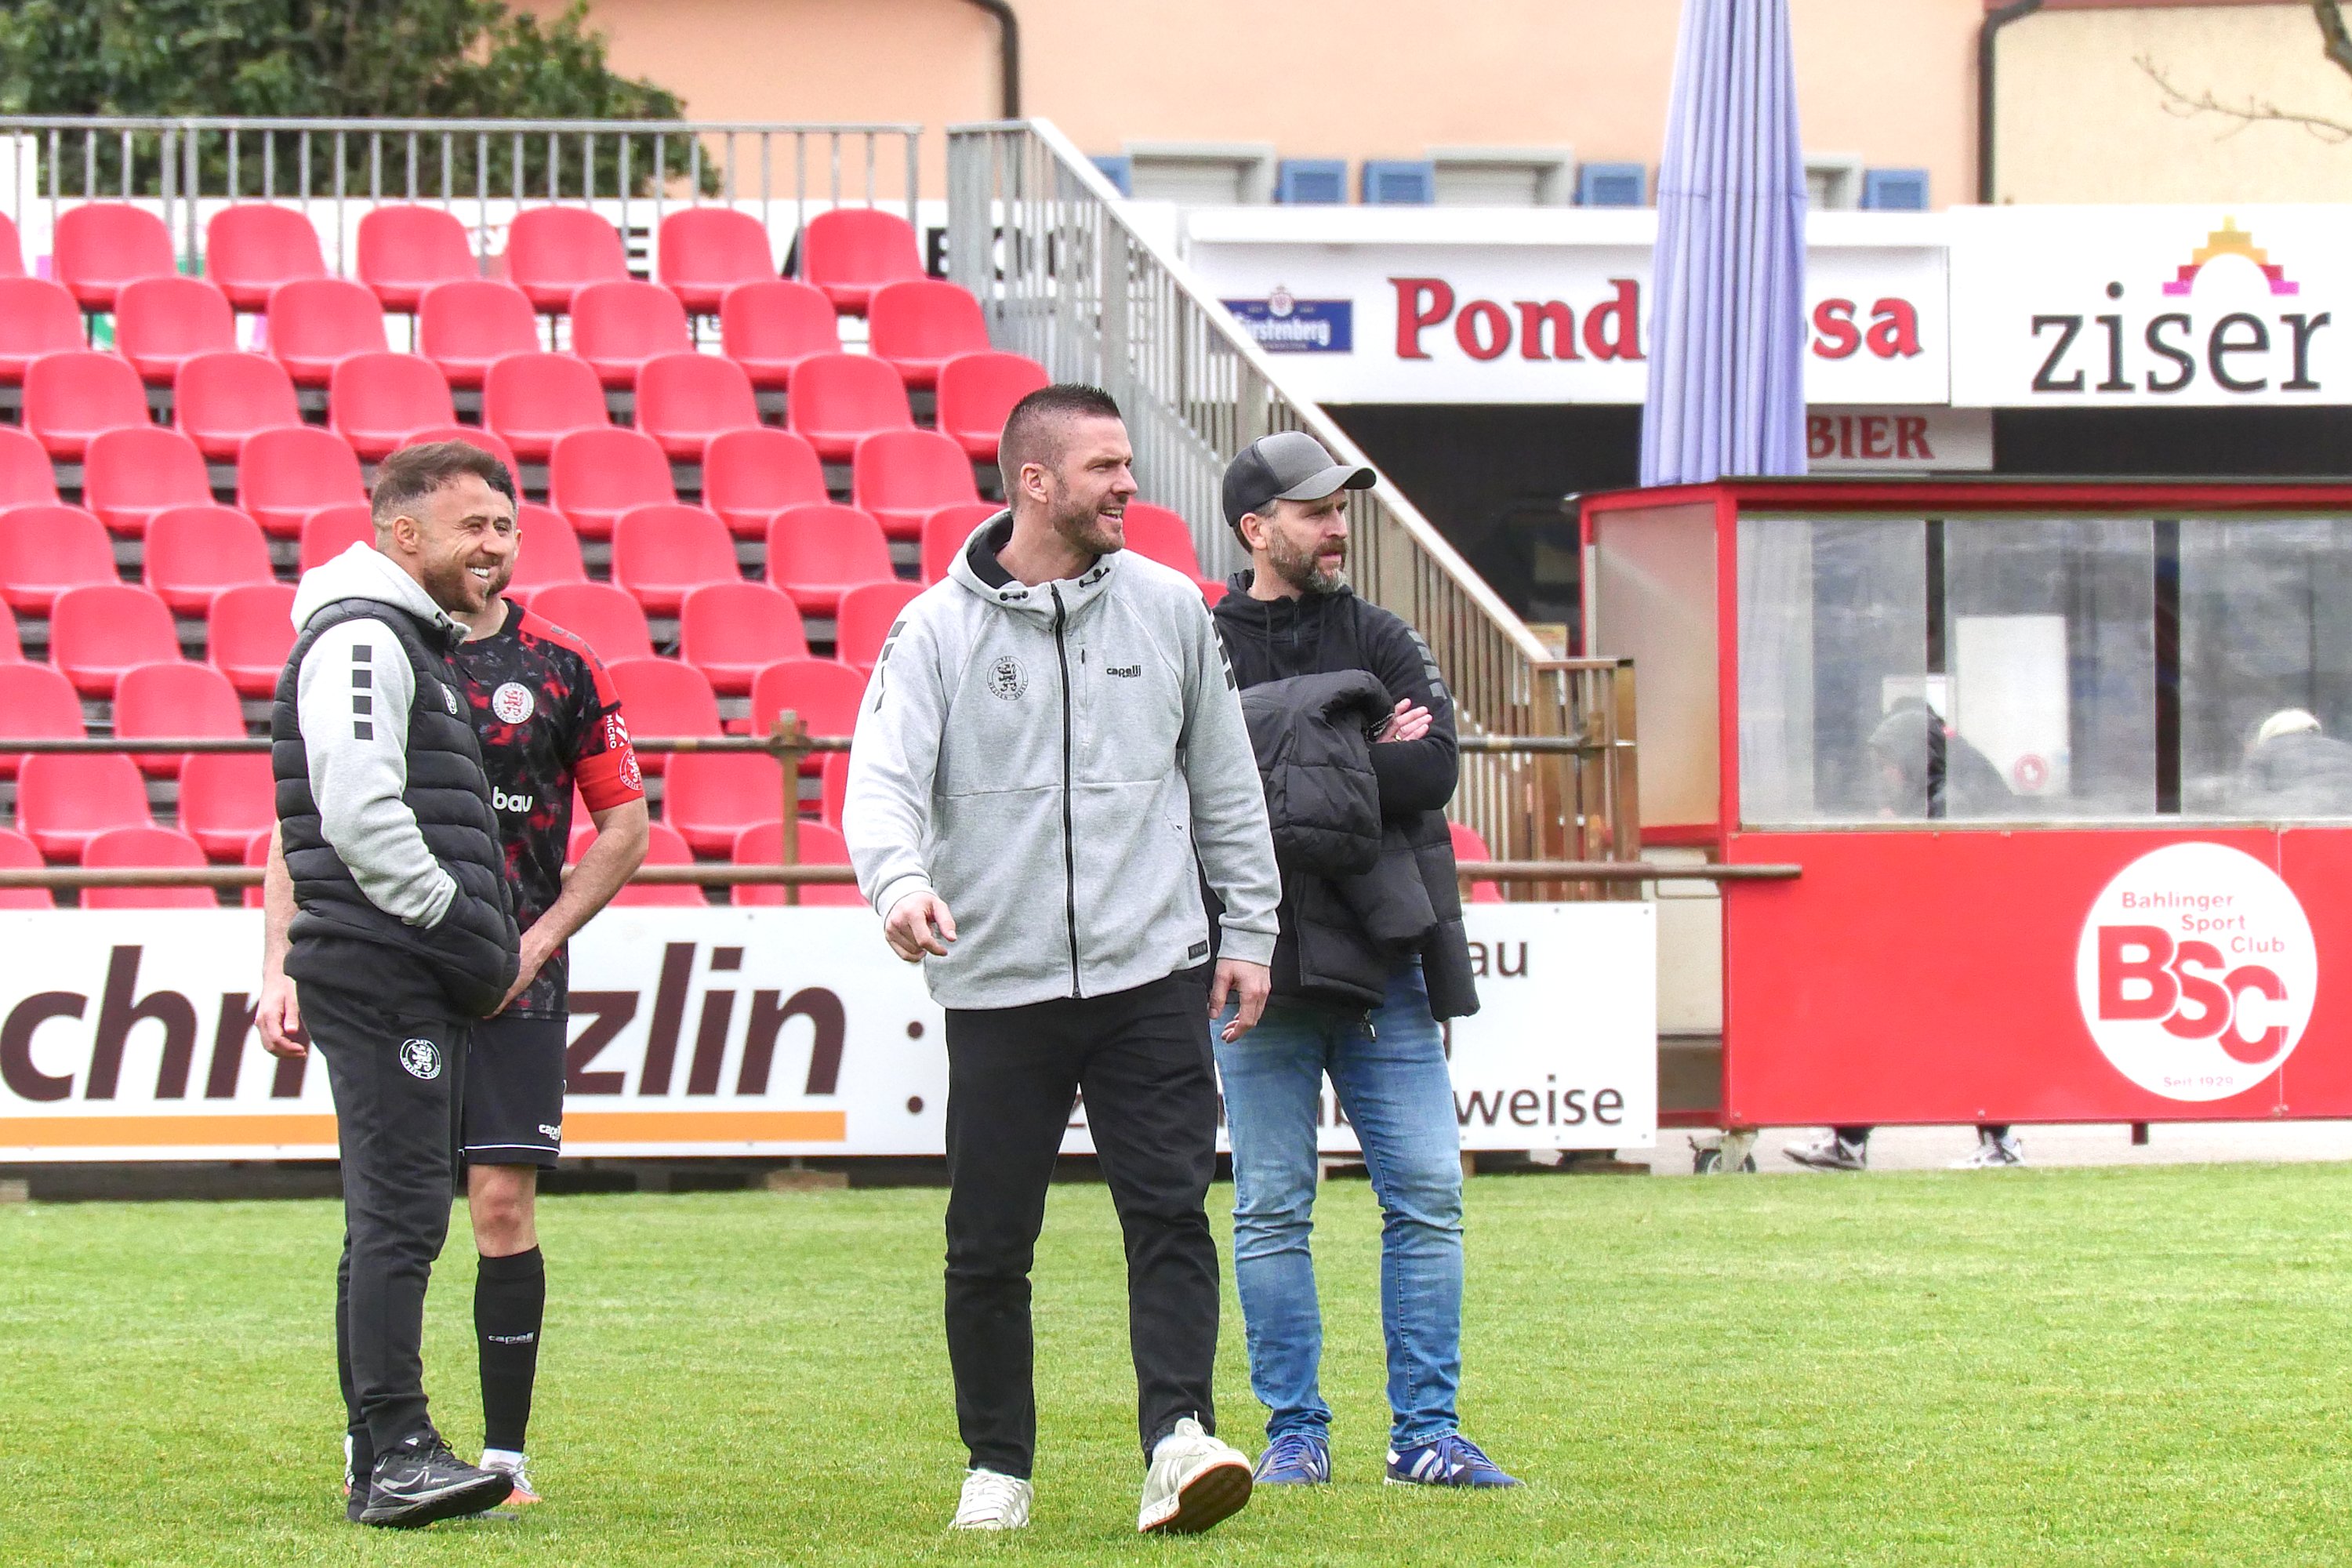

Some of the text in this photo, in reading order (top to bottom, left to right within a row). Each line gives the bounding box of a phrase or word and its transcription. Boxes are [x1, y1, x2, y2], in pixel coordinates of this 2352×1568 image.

[1388, 277, 1923, 361] Pondsa
[2031, 281, 2332, 393] ziser
[1806, 416, 1936, 459] BIER
[606, 714, 617, 750] MICRO
[492, 786, 534, 813] bau
[2122, 891, 2234, 911] Bahlinger
[2181, 913, 2245, 933] Sport
[2231, 936, 2285, 953] Club
[2098, 925, 2289, 1065] BSC
[2163, 1076, 2234, 1088] Seit 1929
